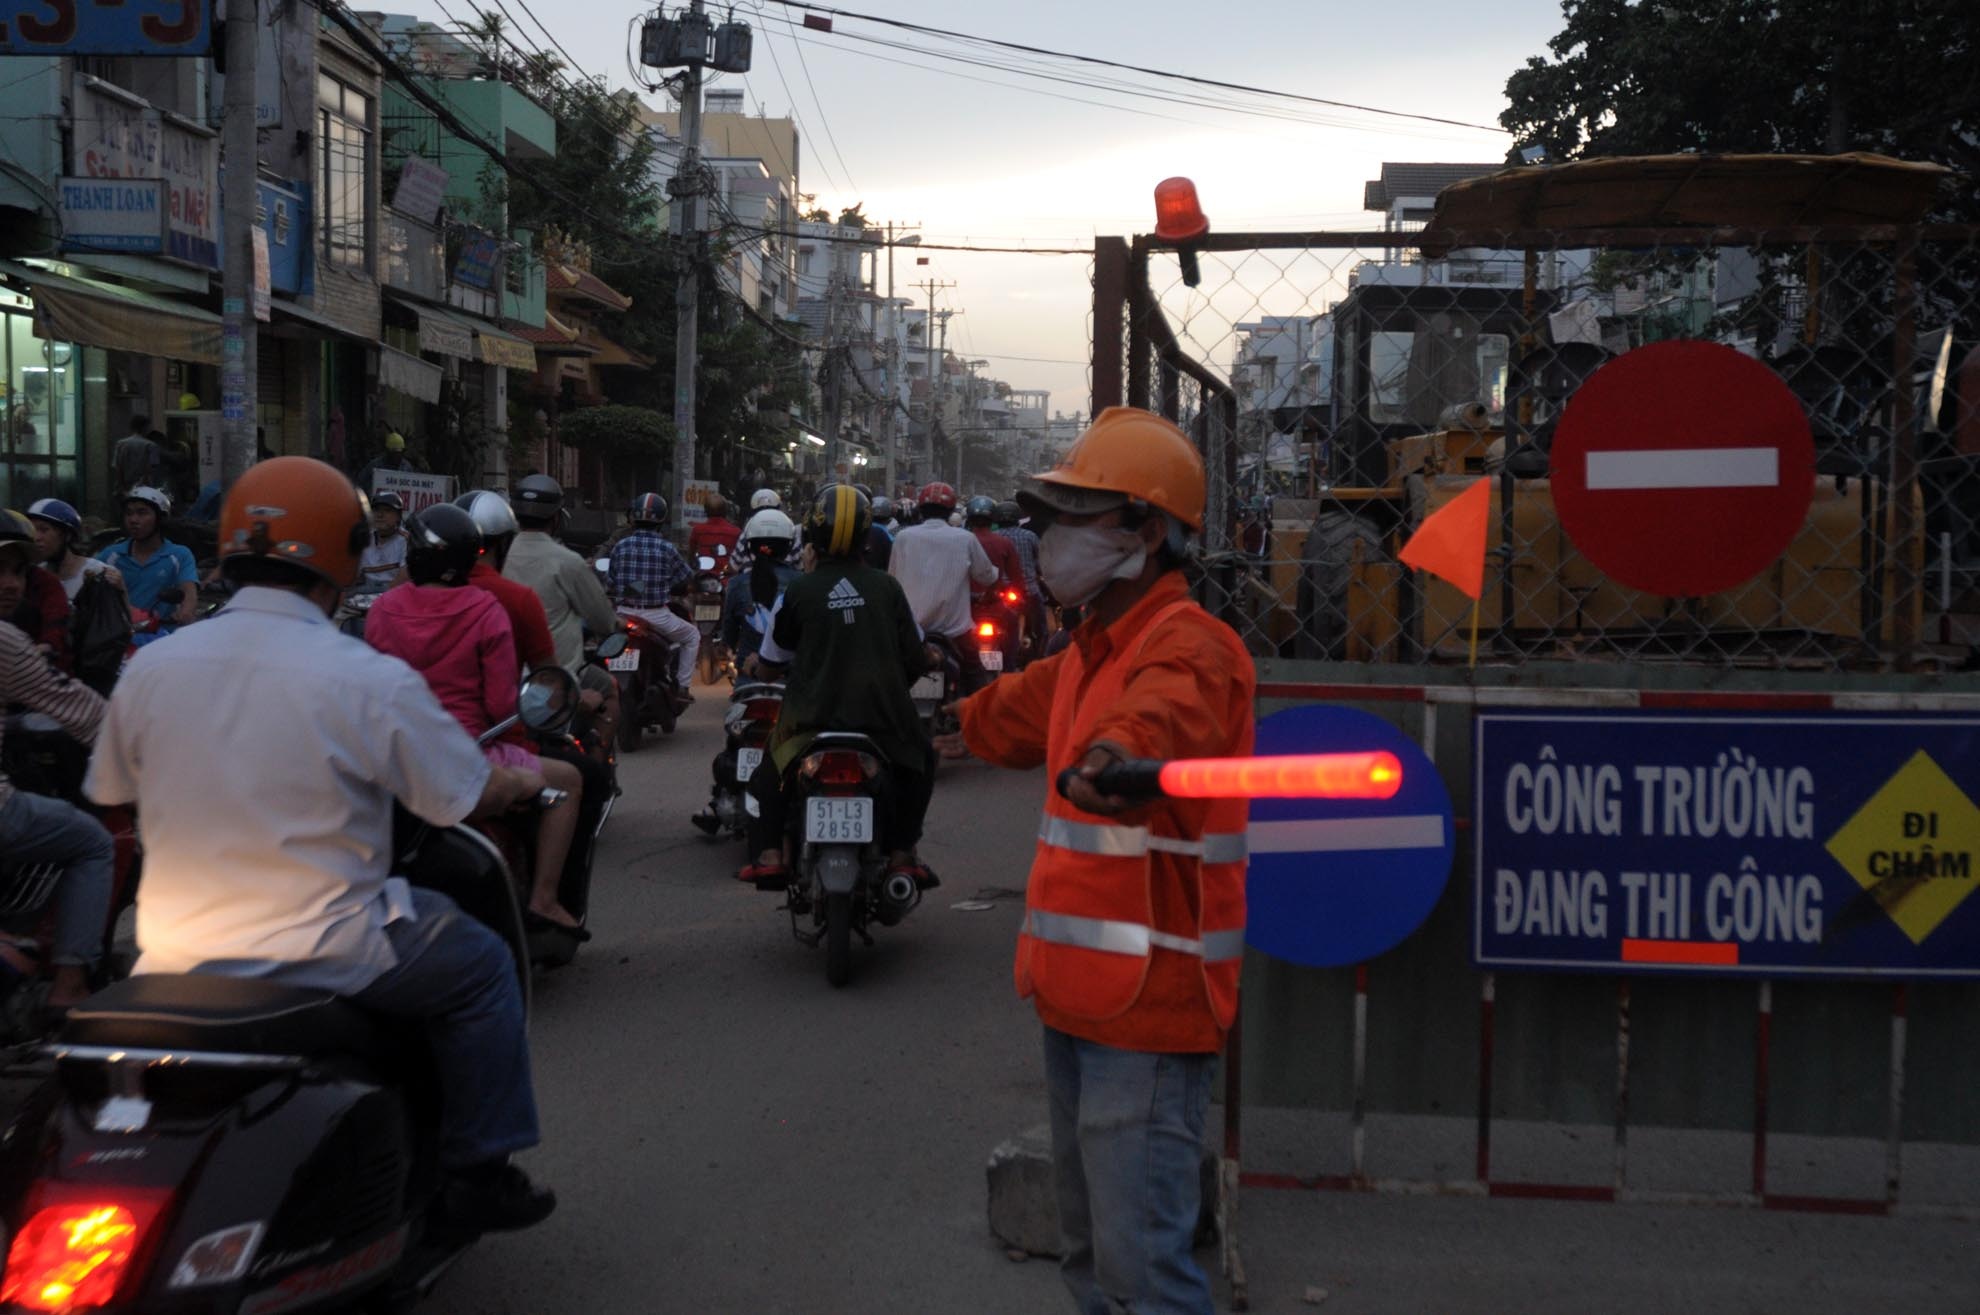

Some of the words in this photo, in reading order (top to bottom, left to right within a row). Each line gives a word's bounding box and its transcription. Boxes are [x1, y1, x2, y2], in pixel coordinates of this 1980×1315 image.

[63, 185, 113, 210] THANH
[116, 187, 156, 211] LOAN
[827, 597, 865, 609] adidas
[1505, 745, 1623, 836] CÔNG
[1633, 747, 1815, 839] TRƯỜNG
[816, 821, 863, 839] 2859
[1903, 810, 1938, 838] ĐI
[1495, 869, 1608, 939] ĐANG
[1620, 872, 1691, 940] THI
[1705, 856, 1824, 944] CÔNG
